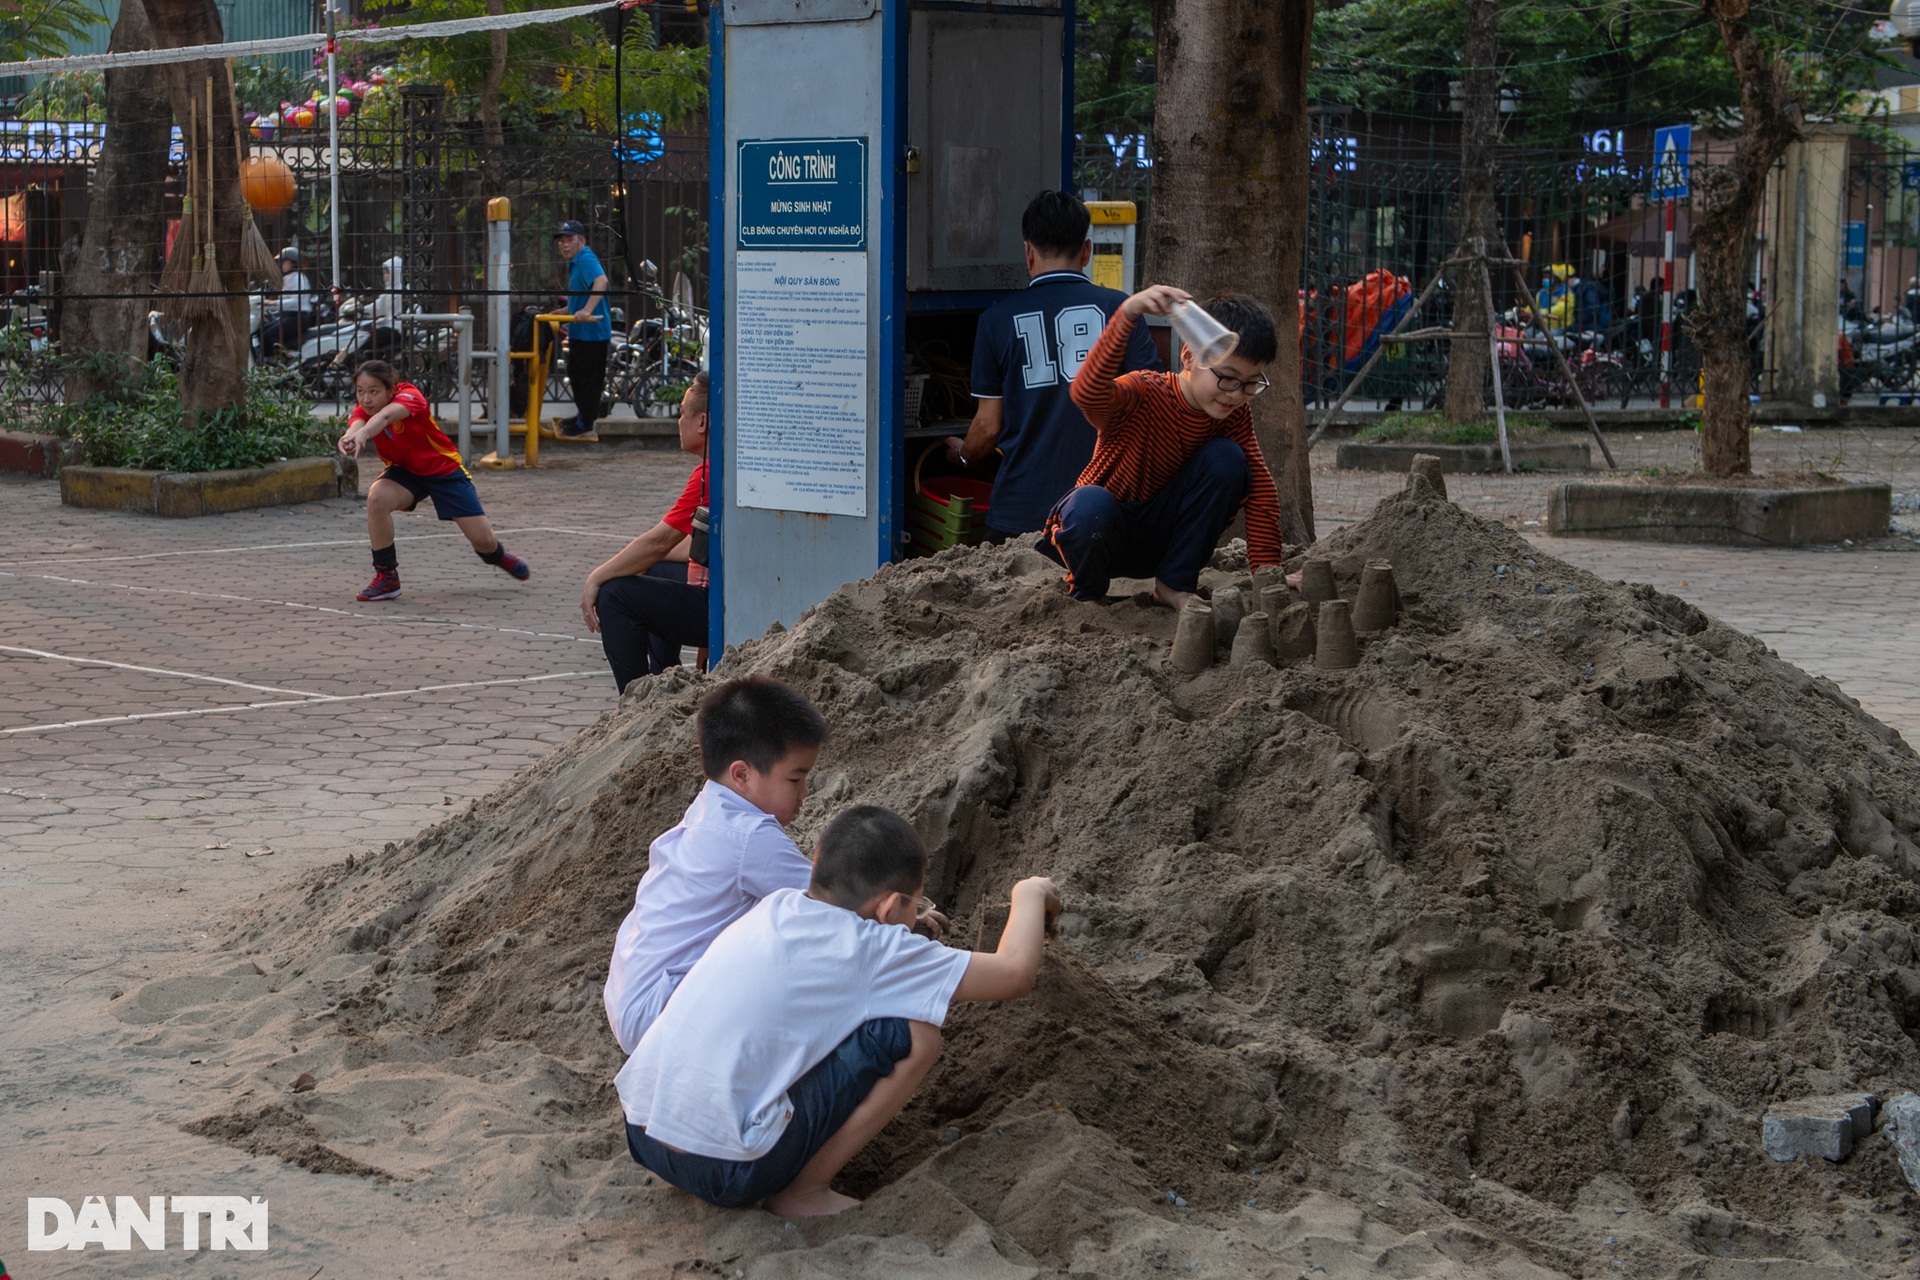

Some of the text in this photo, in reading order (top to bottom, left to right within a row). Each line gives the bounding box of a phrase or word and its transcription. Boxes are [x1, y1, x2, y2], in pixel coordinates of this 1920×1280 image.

[769, 149, 836, 179] CÔNG TRÌNH
[771, 199, 832, 215] MỪNG SINH NHẬT
[742, 226, 755, 235] CLB
[757, 225, 775, 235] BÓNG
[818, 226, 827, 235] CV
[851, 225, 861, 235] ĐÔ
[774, 275, 840, 286] NỘI QUY SÂN BÓNG
[1013, 304, 1106, 389] 18
